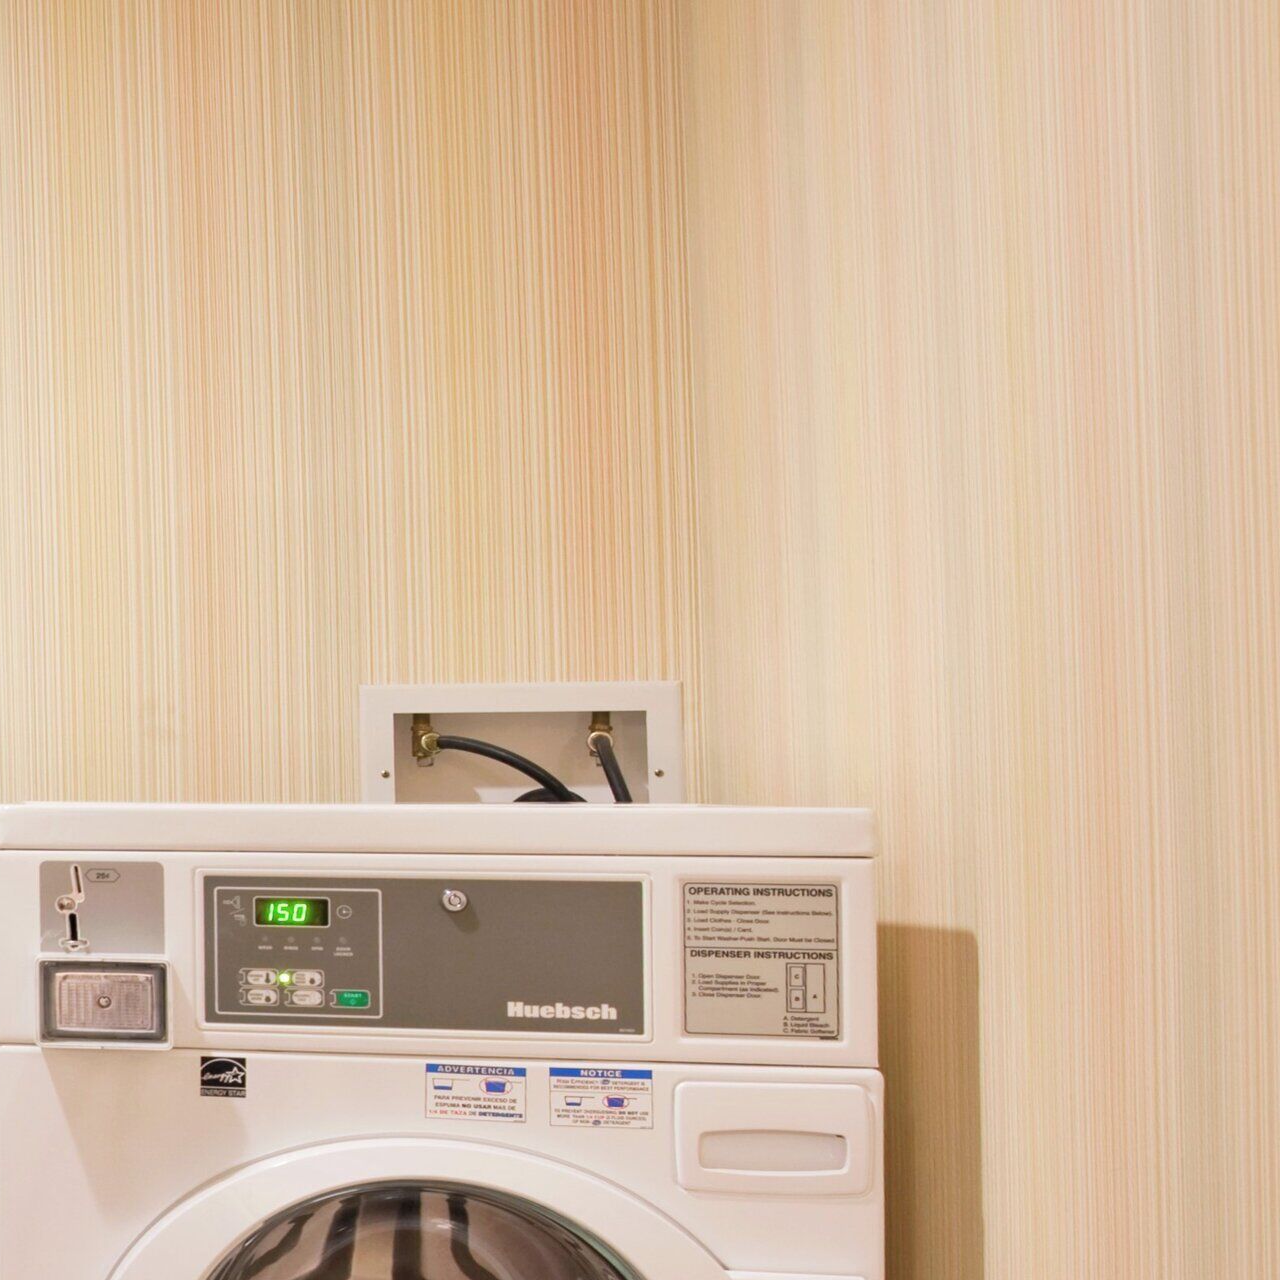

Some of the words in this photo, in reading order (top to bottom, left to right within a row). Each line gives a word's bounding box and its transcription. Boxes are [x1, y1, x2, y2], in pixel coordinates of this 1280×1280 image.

[688, 887, 750, 896] OPERATING
[752, 888, 833, 897] INSTRUCTIONS
[268, 903, 307, 922] 150
[690, 949, 751, 959] DISPENSER
[753, 951, 833, 960] INSTRUCTIONS
[507, 1001, 618, 1020] Huebsch
[437, 1065, 515, 1075] ADVERTENCIA
